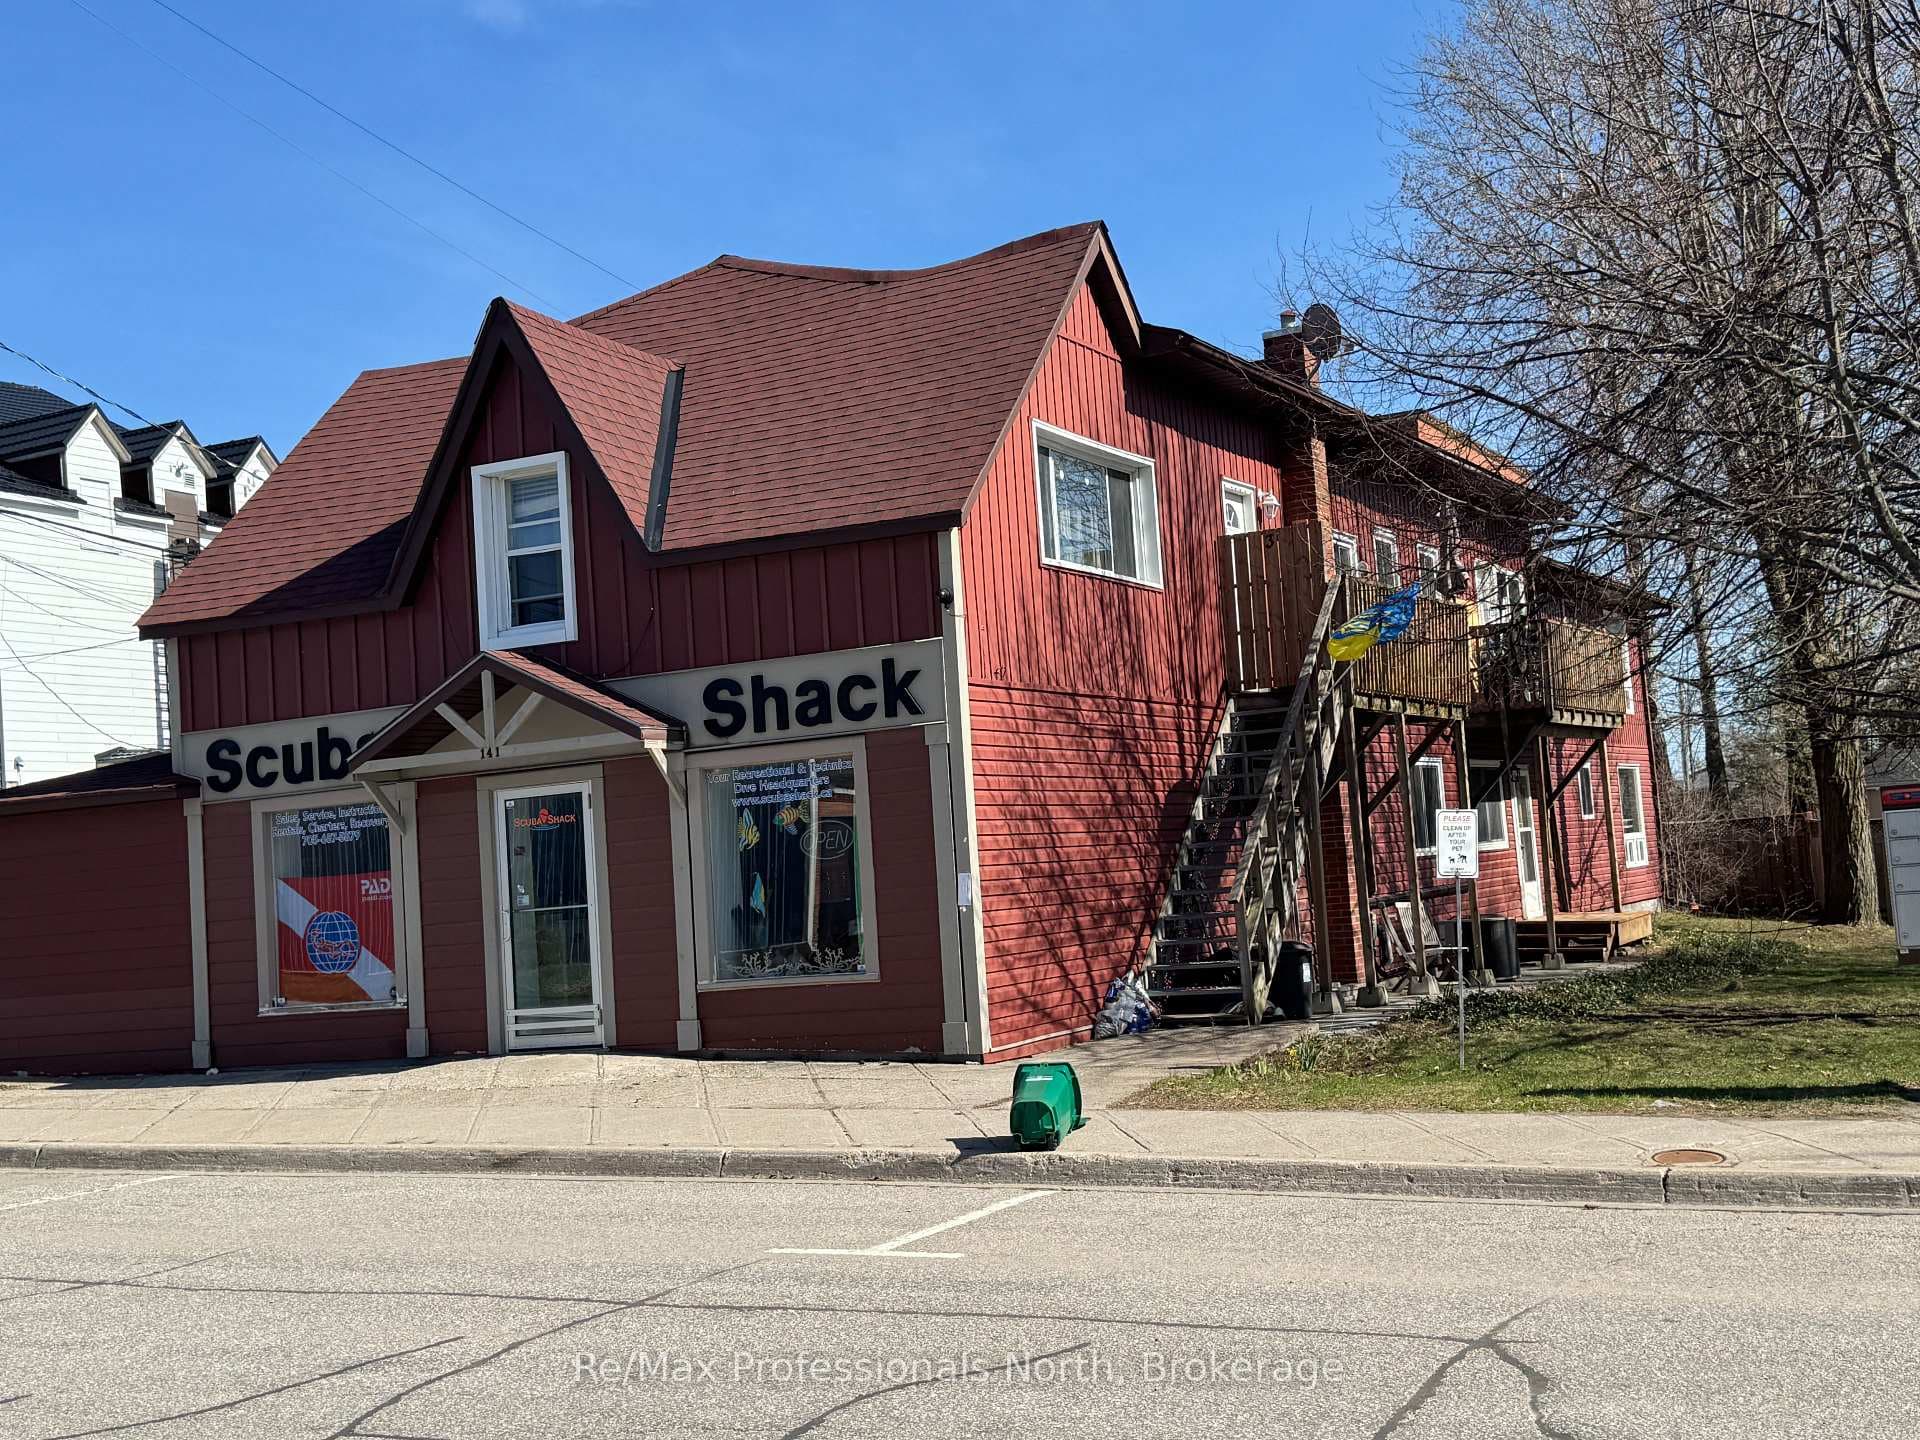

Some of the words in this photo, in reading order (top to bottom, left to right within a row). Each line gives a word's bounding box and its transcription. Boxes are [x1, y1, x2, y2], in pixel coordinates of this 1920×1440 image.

[702, 657, 925, 738] Shack
[481, 746, 500, 759] 141
[732, 763, 795, 781] Recreational
[797, 762, 807, 775] &
[733, 782, 758, 795] Dive
[759, 774, 830, 793] Headquarters
[302, 808, 337, 822] Service,
[514, 817, 542, 827] SCUBA
[547, 815, 576, 824] SHACK
[307, 821, 348, 834] Charters,
[803, 829, 849, 851] OPEN
[360, 878, 391, 895] PAD
